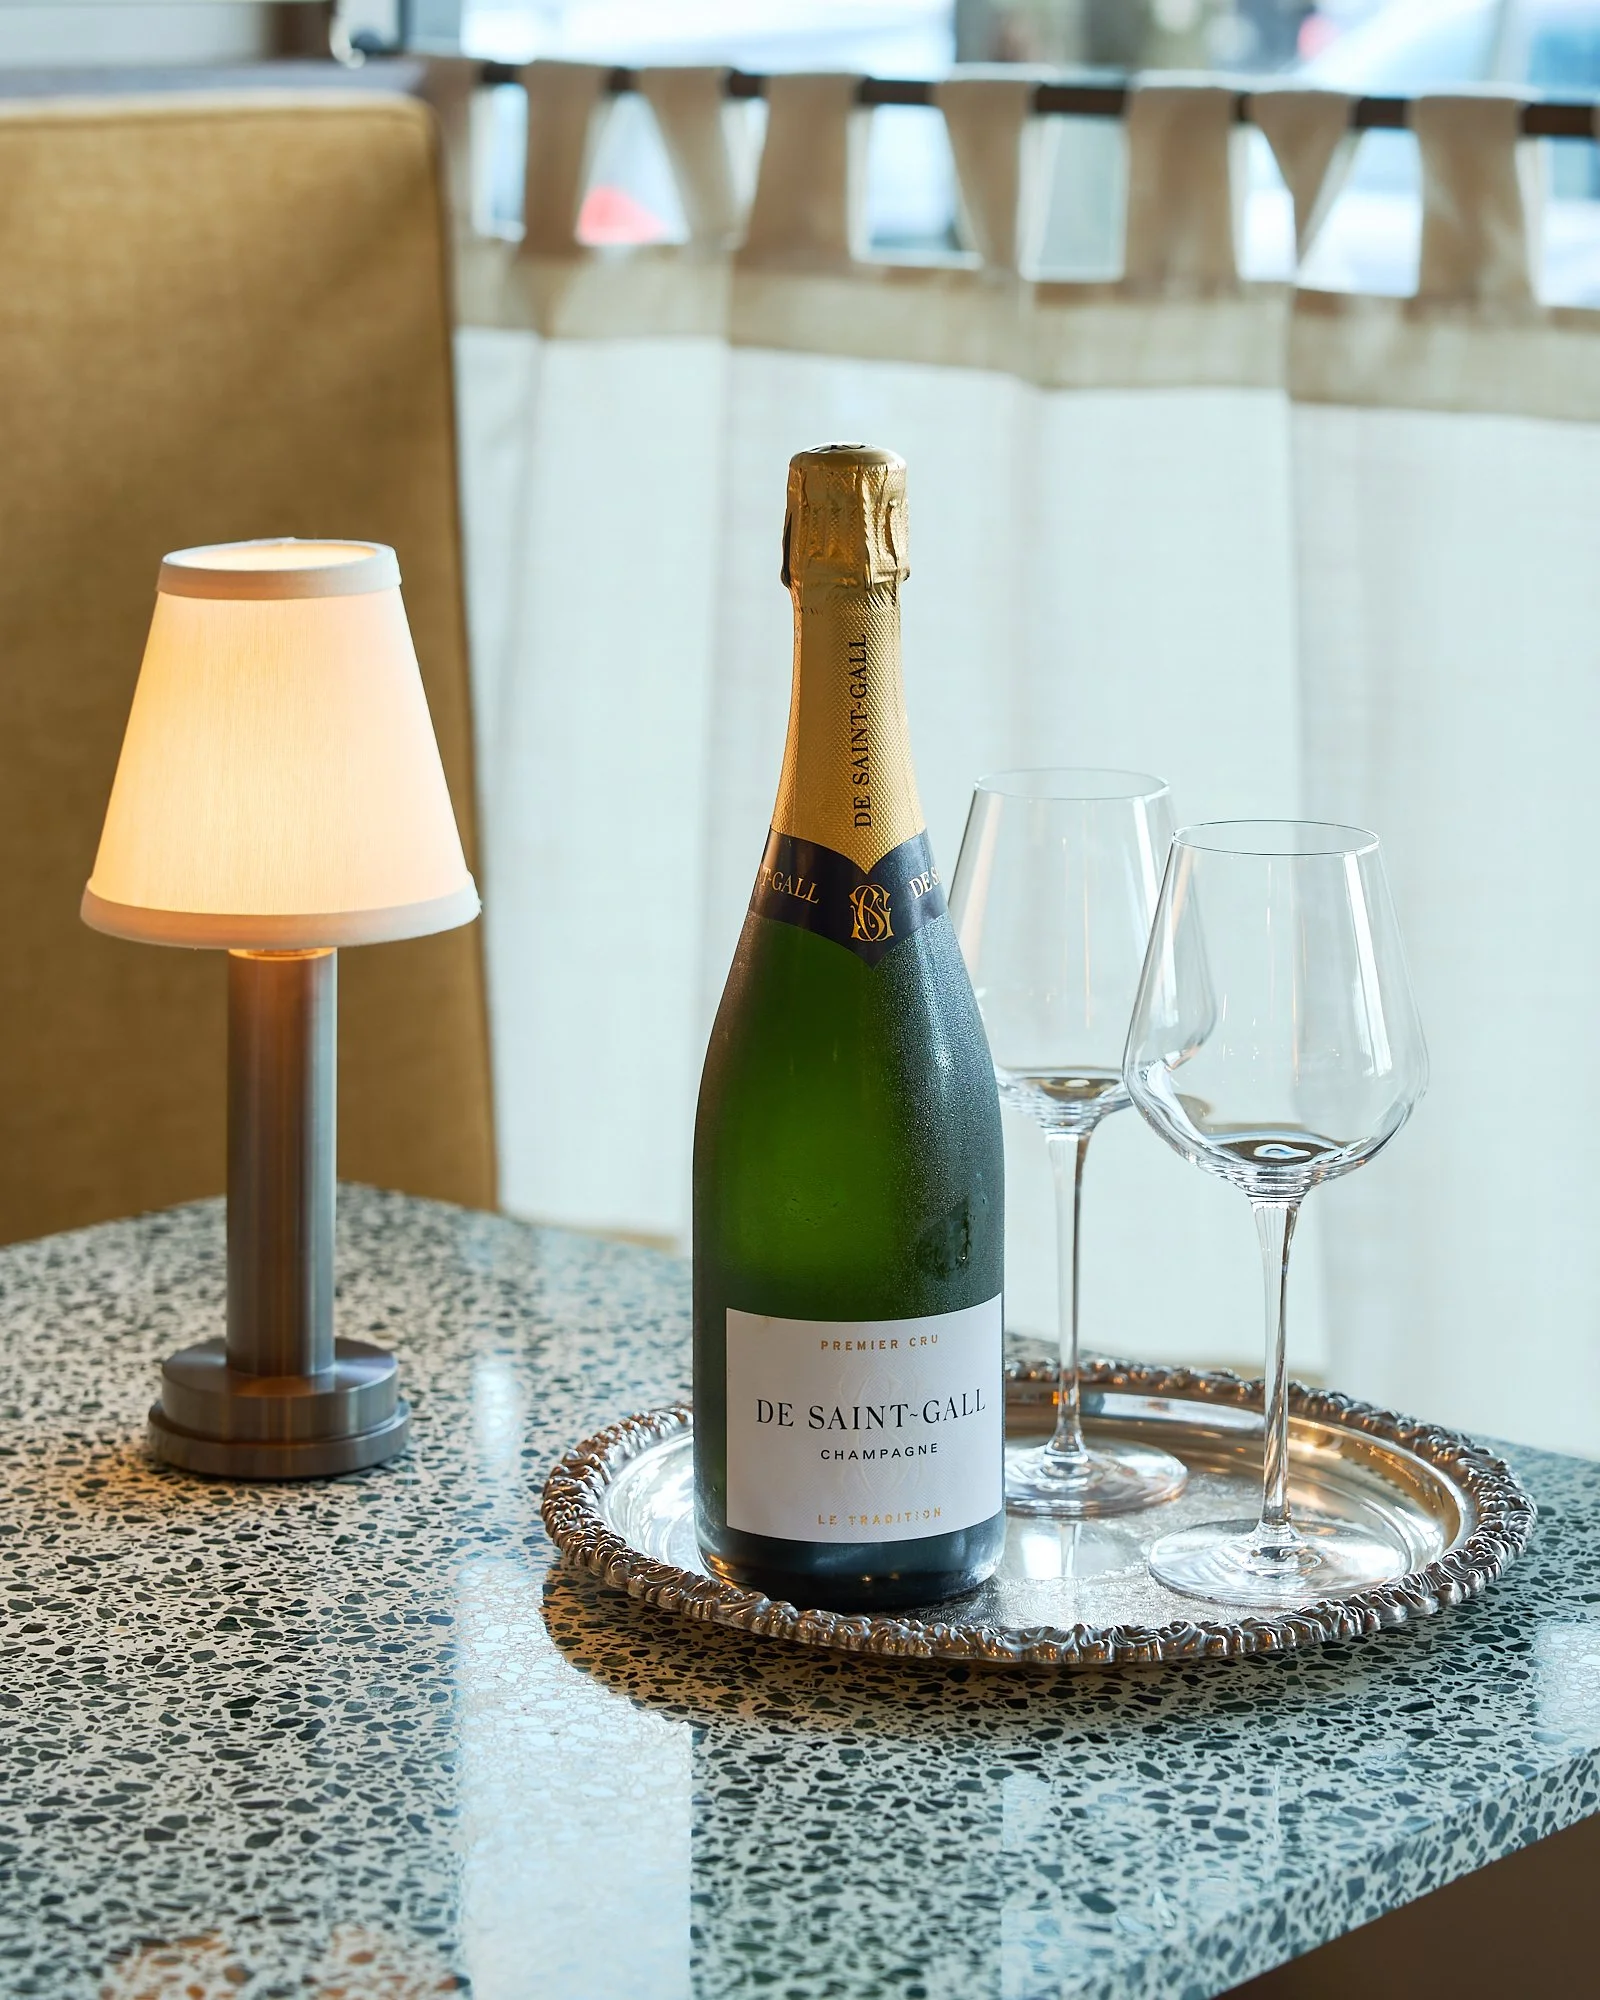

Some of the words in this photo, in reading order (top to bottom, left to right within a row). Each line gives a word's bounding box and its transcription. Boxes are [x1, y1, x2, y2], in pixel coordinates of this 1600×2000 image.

[853, 795, 872, 829] DE
[909, 871, 932, 900] DE
[820, 1339, 899, 1351] PREMIER
[908, 1333, 939, 1348] CRU
[756, 1398, 795, 1428] DE
[820, 1442, 939, 1461] CHAMPAGNE
[817, 1513, 838, 1526] LE
[847, 1506, 942, 1527] TRADITION
